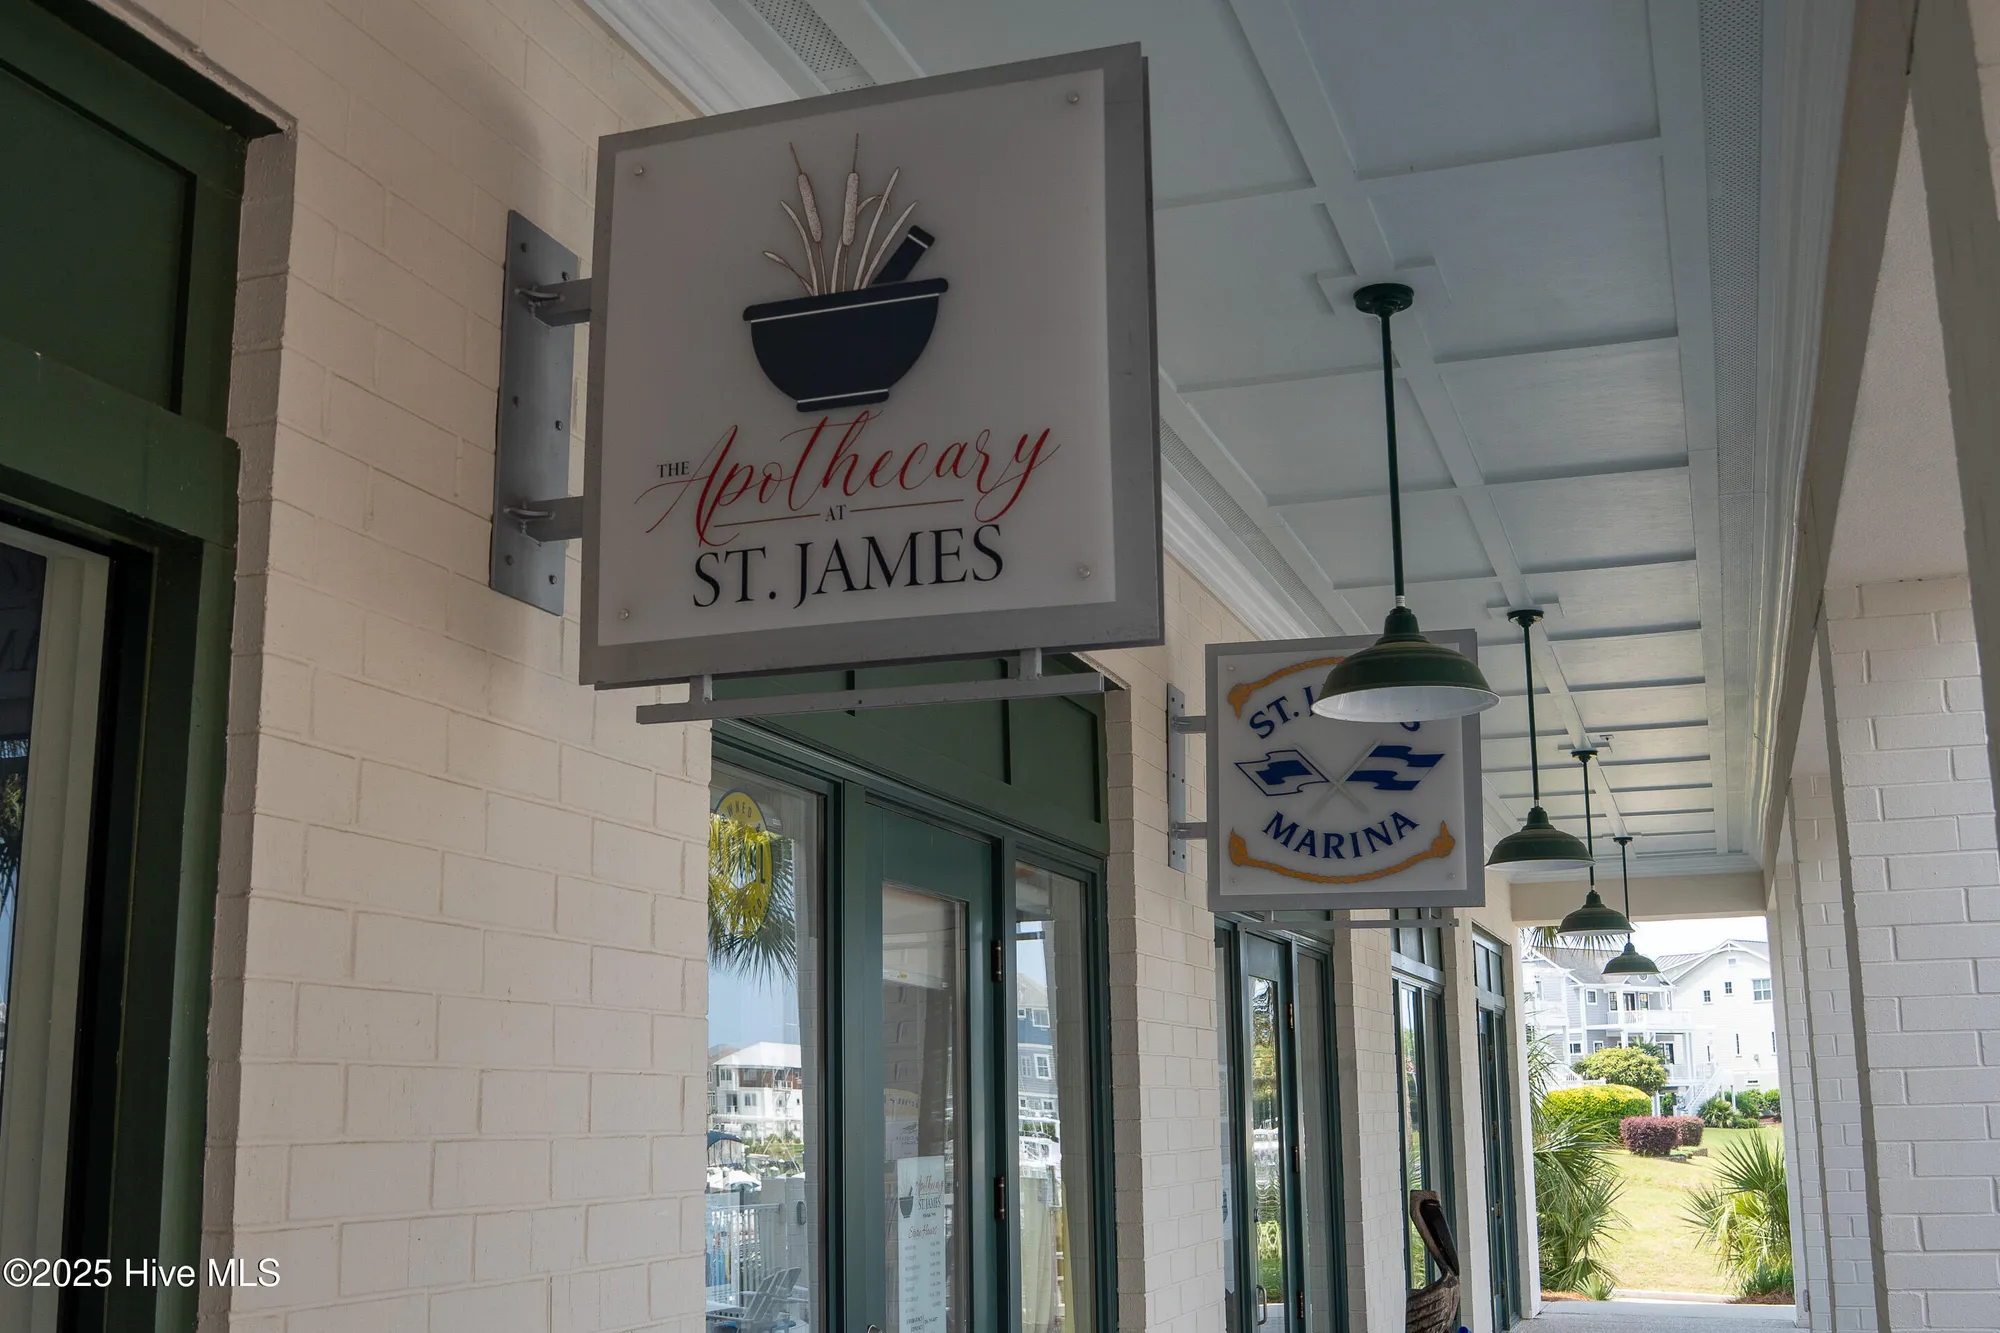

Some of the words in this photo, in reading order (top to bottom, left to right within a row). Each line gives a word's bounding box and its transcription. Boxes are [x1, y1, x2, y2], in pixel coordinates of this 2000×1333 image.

[634, 410, 1062, 547] Apothecary
[656, 460, 690, 480] THE
[824, 504, 848, 523] AT
[691, 545, 778, 609] ST.
[792, 523, 1004, 610] JAMES
[1249, 695, 1300, 740] ST.
[1262, 811, 1420, 860] MARINA
